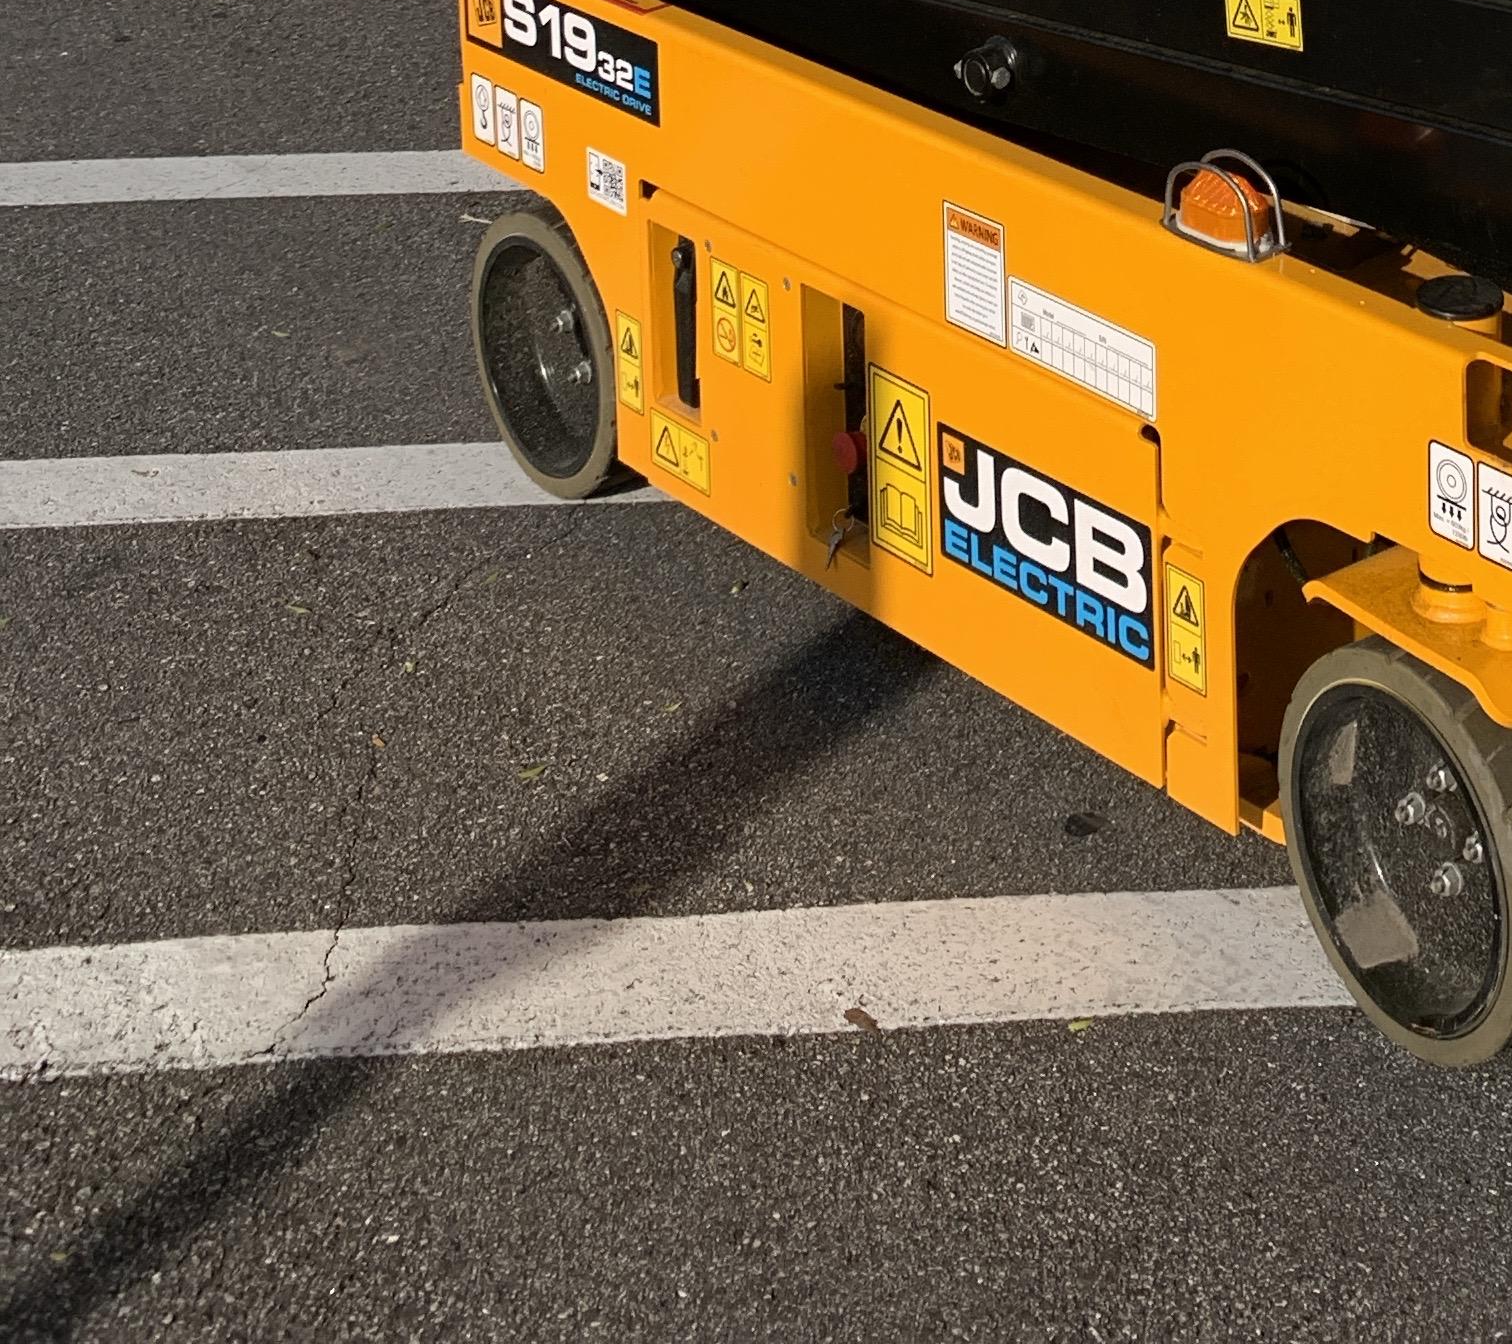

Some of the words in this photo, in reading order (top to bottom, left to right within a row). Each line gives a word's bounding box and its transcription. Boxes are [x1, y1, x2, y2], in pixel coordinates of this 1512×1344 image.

[575, 72, 620, 102] ELECTRIC
[622, 93, 653, 116] DRIVE
[960, 217, 999, 247] WARNING
[943, 449, 1148, 614] JCB
[943, 518, 1150, 662] ELECTRIC
